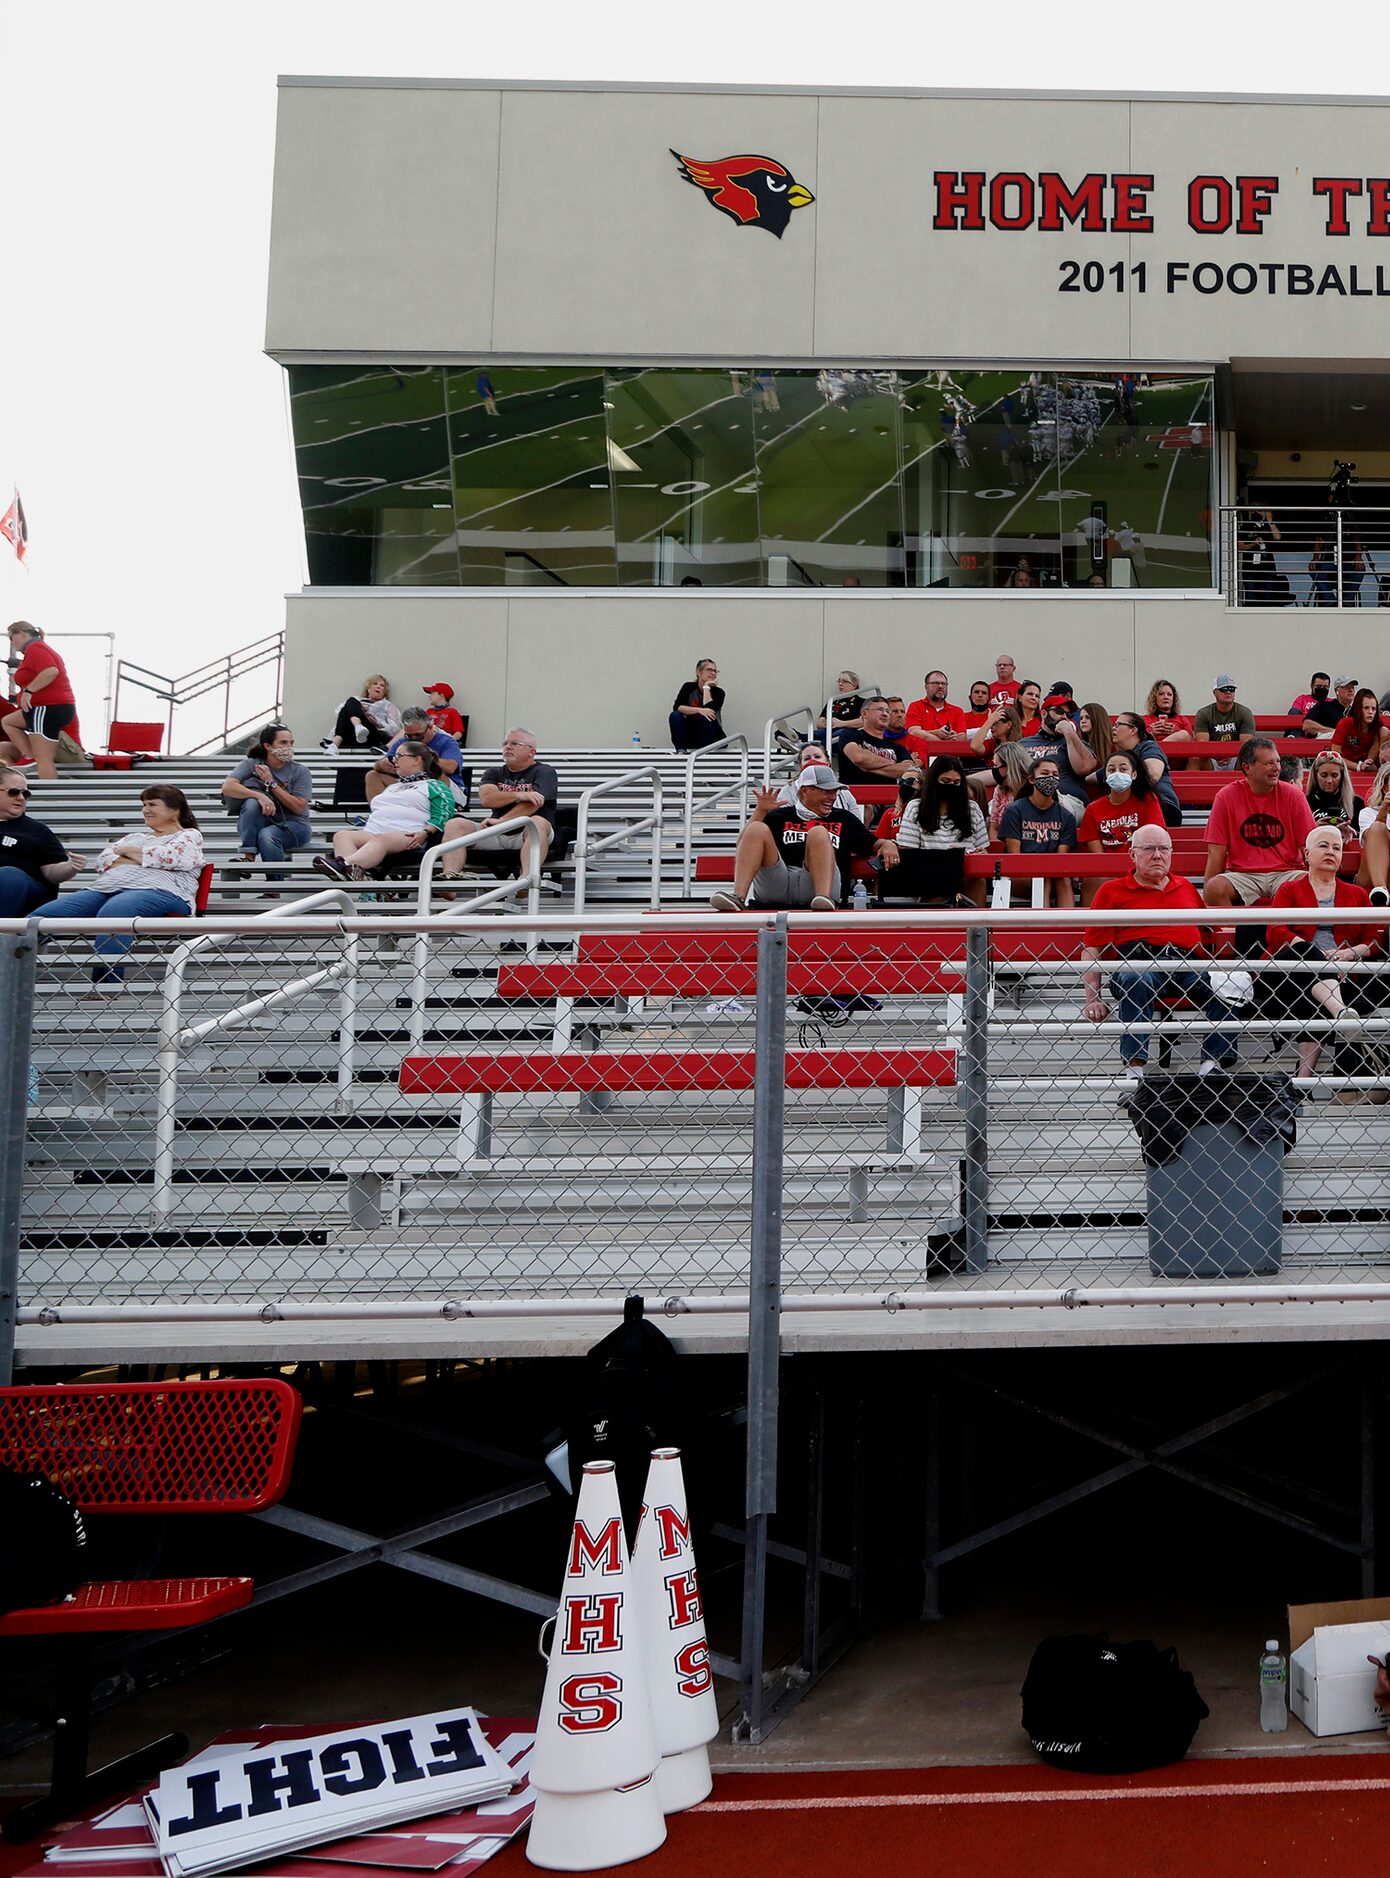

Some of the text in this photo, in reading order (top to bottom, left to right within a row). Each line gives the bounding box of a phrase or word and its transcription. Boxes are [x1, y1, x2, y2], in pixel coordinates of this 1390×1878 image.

[933, 171, 1154, 233] HOME
[1188, 175, 1279, 235] OF
[1059, 261, 1146, 293] 2011
[169, 1718, 487, 1837] FIGHT
